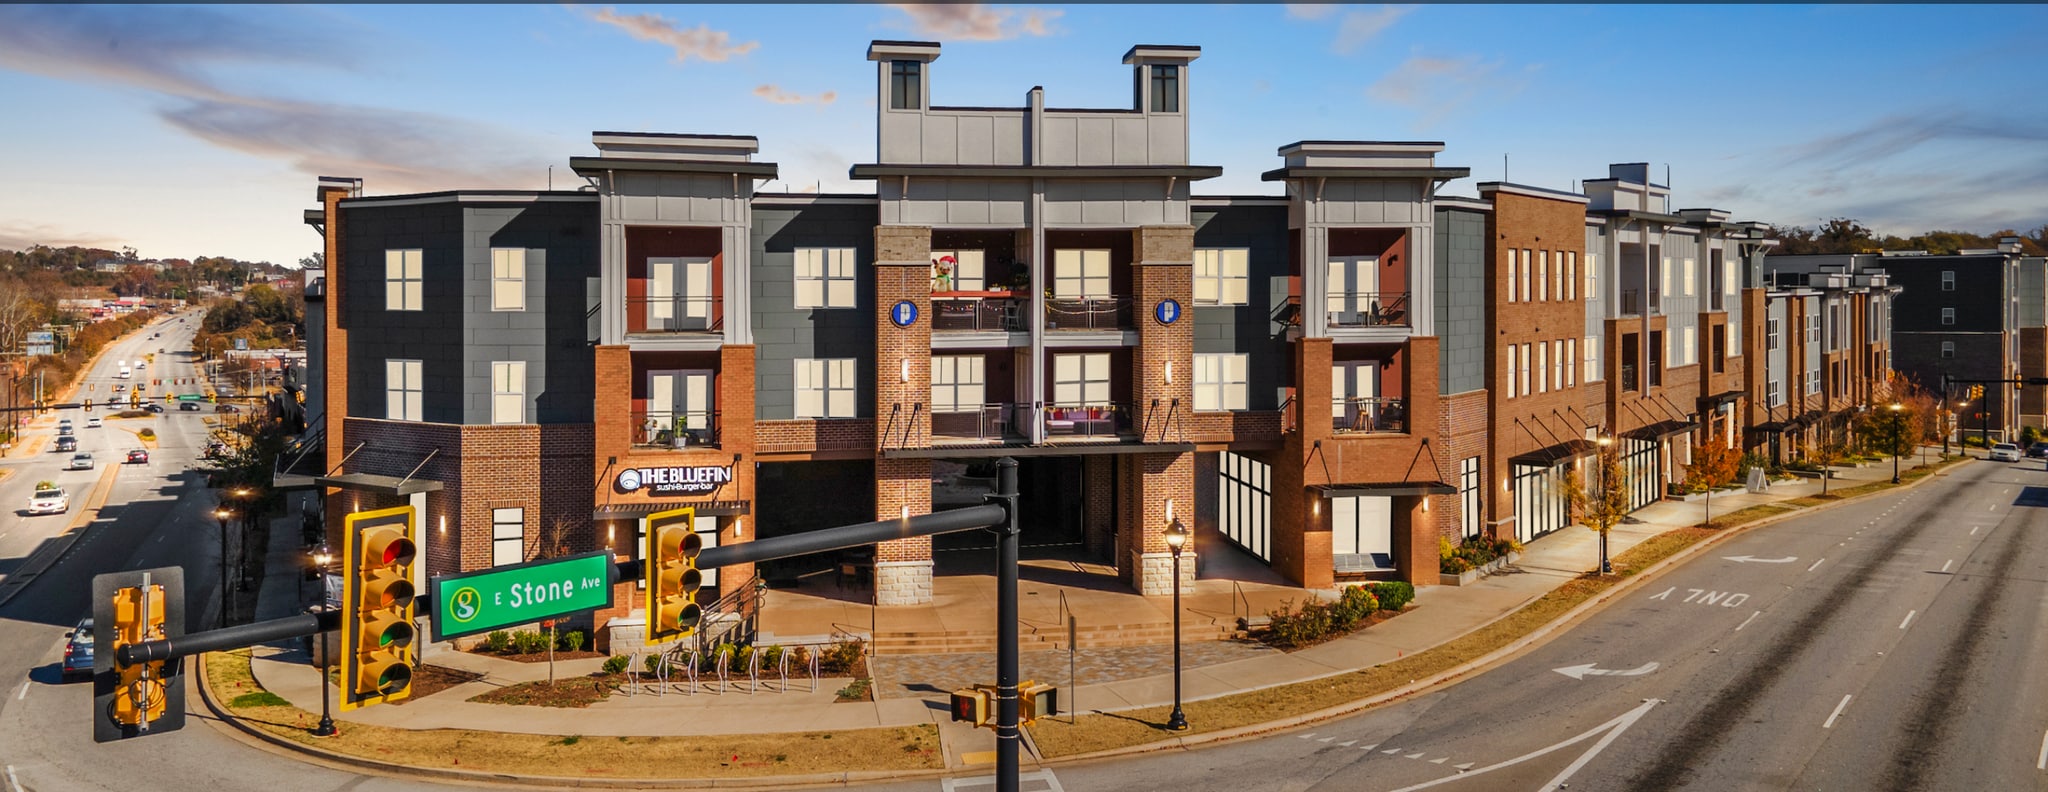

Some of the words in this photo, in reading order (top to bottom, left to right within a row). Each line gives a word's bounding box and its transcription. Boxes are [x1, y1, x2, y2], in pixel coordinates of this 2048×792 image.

[639, 468, 669, 484] THE
[669, 467, 731, 483] BLUEFIN
[495, 592, 502, 605] E
[510, 580, 573, 608] Stone
[581, 576, 600, 590] Ave
[1648, 586, 1751, 608] ONLY
